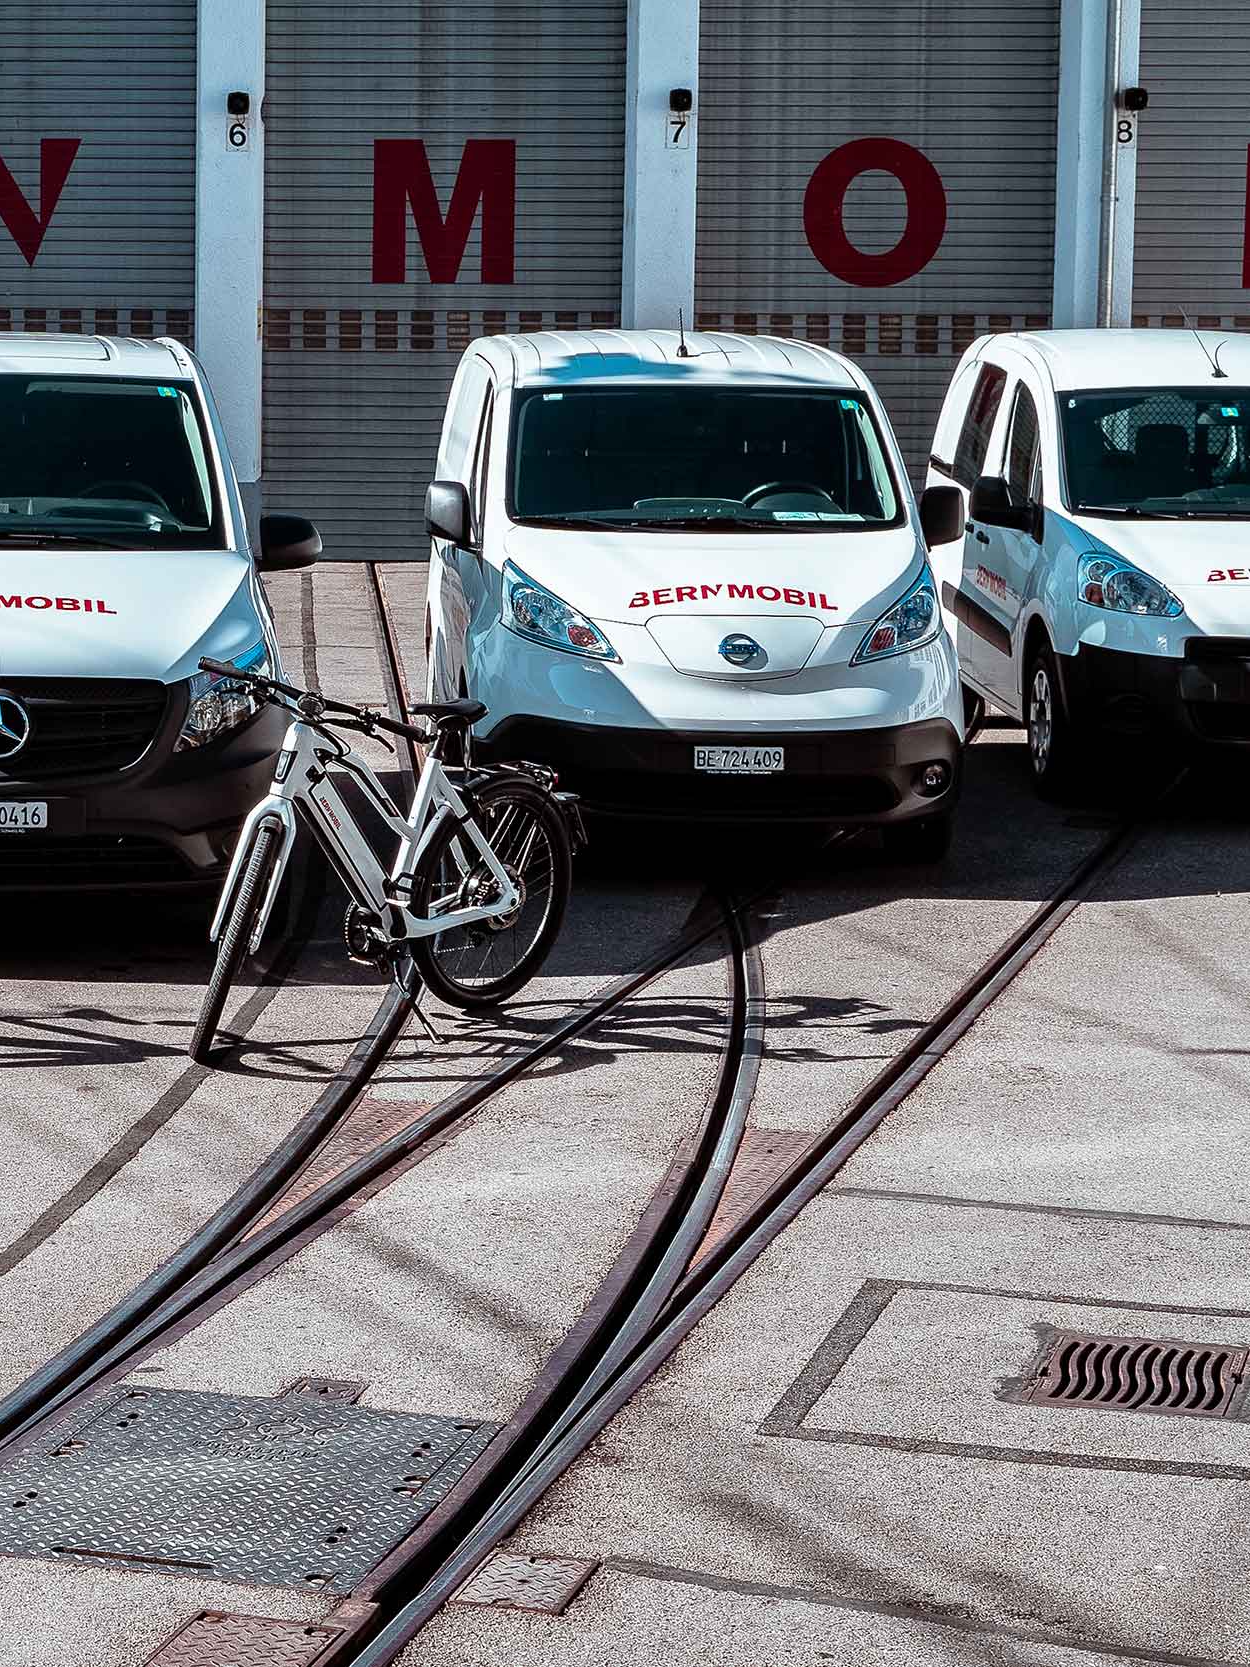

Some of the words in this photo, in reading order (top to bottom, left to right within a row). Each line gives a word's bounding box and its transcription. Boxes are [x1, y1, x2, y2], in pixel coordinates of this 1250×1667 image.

[229, 123, 246, 147] 6
[669, 120, 686, 143] 7
[1117, 120, 1133, 143] 8
[372, 139, 516, 284] M
[803, 137, 948, 288] O
[1207, 568, 1250, 582] BE
[628, 583, 839, 611] BERNMOBIL
